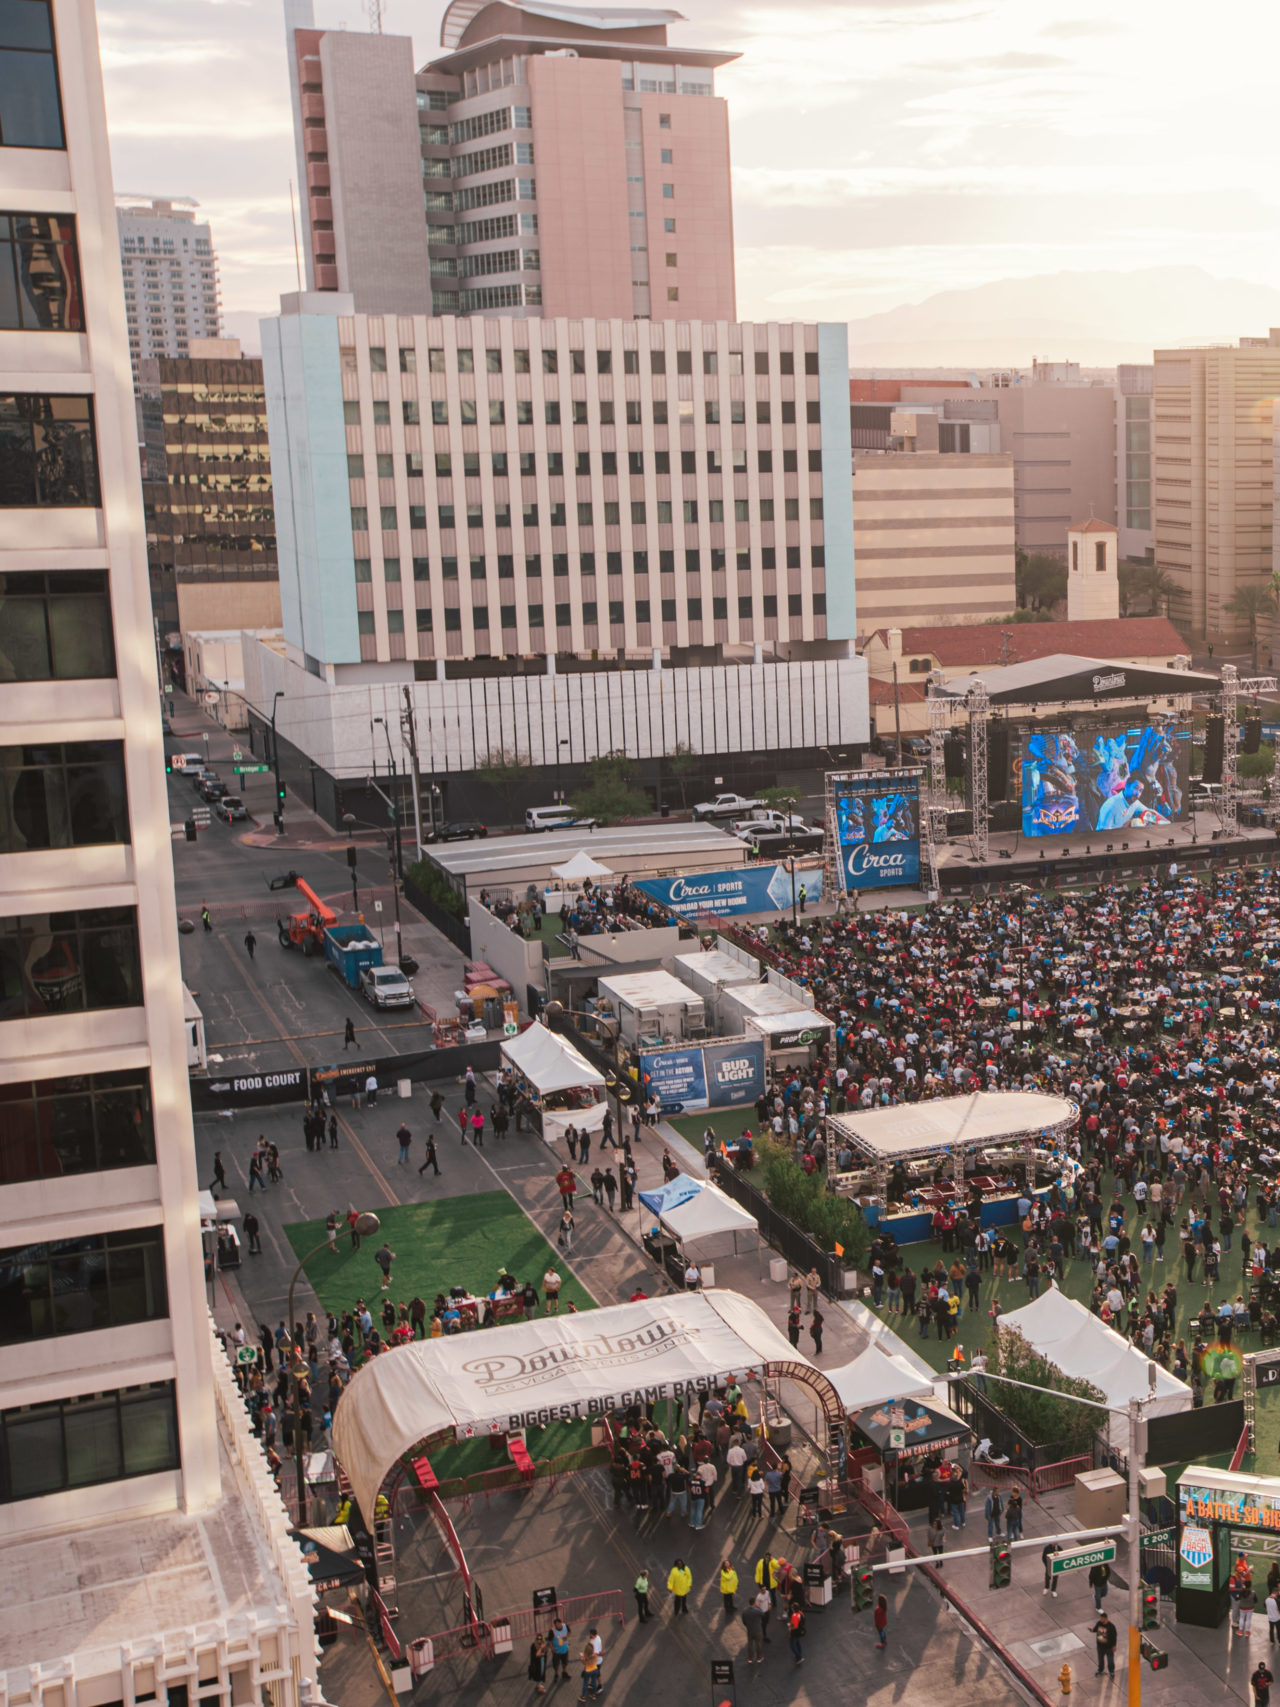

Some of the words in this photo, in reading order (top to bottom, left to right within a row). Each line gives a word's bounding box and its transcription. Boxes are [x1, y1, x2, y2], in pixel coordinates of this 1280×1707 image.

[847, 843, 906, 876] Circa
[880, 867, 903, 877] SPORTS
[669, 878, 711, 901] Circa
[718, 881, 743, 892] SPORTS
[714, 898, 727, 907] NEW
[779, 1035, 798, 1044] PROP
[802, 1032, 822, 1042] SWAP
[718, 1067, 754, 1082] LIGHT
[722, 1059, 749, 1072] BUD
[234, 1076, 262, 1091] FOOD
[265, 1072, 301, 1088] COURT
[462, 1319, 701, 1384] Downtown
[485, 1383, 515, 1396] LAS
[520, 1365, 575, 1385] VEGAS
[508, 1402, 581, 1431] BIGGEST
[588, 1396, 615, 1414] BIG
[621, 1385, 667, 1408] GAME
[673, 1375, 718, 1397] BASH
[898, 1449, 912, 1459] MAN
[914, 1444, 929, 1455] CAVE
[931, 1436, 959, 1451] CHECK-IN
[1186, 1498, 1194, 1516] A
[1197, 1500, 1241, 1522] BATTLE
[1243, 1506, 1259, 1525] SO
[1143, 1537, 1149, 1545] E
[1152, 1533, 1169, 1543] 200
[1186, 1541, 1207, 1553] BASH
[1063, 1552, 1104, 1569] CARSON
